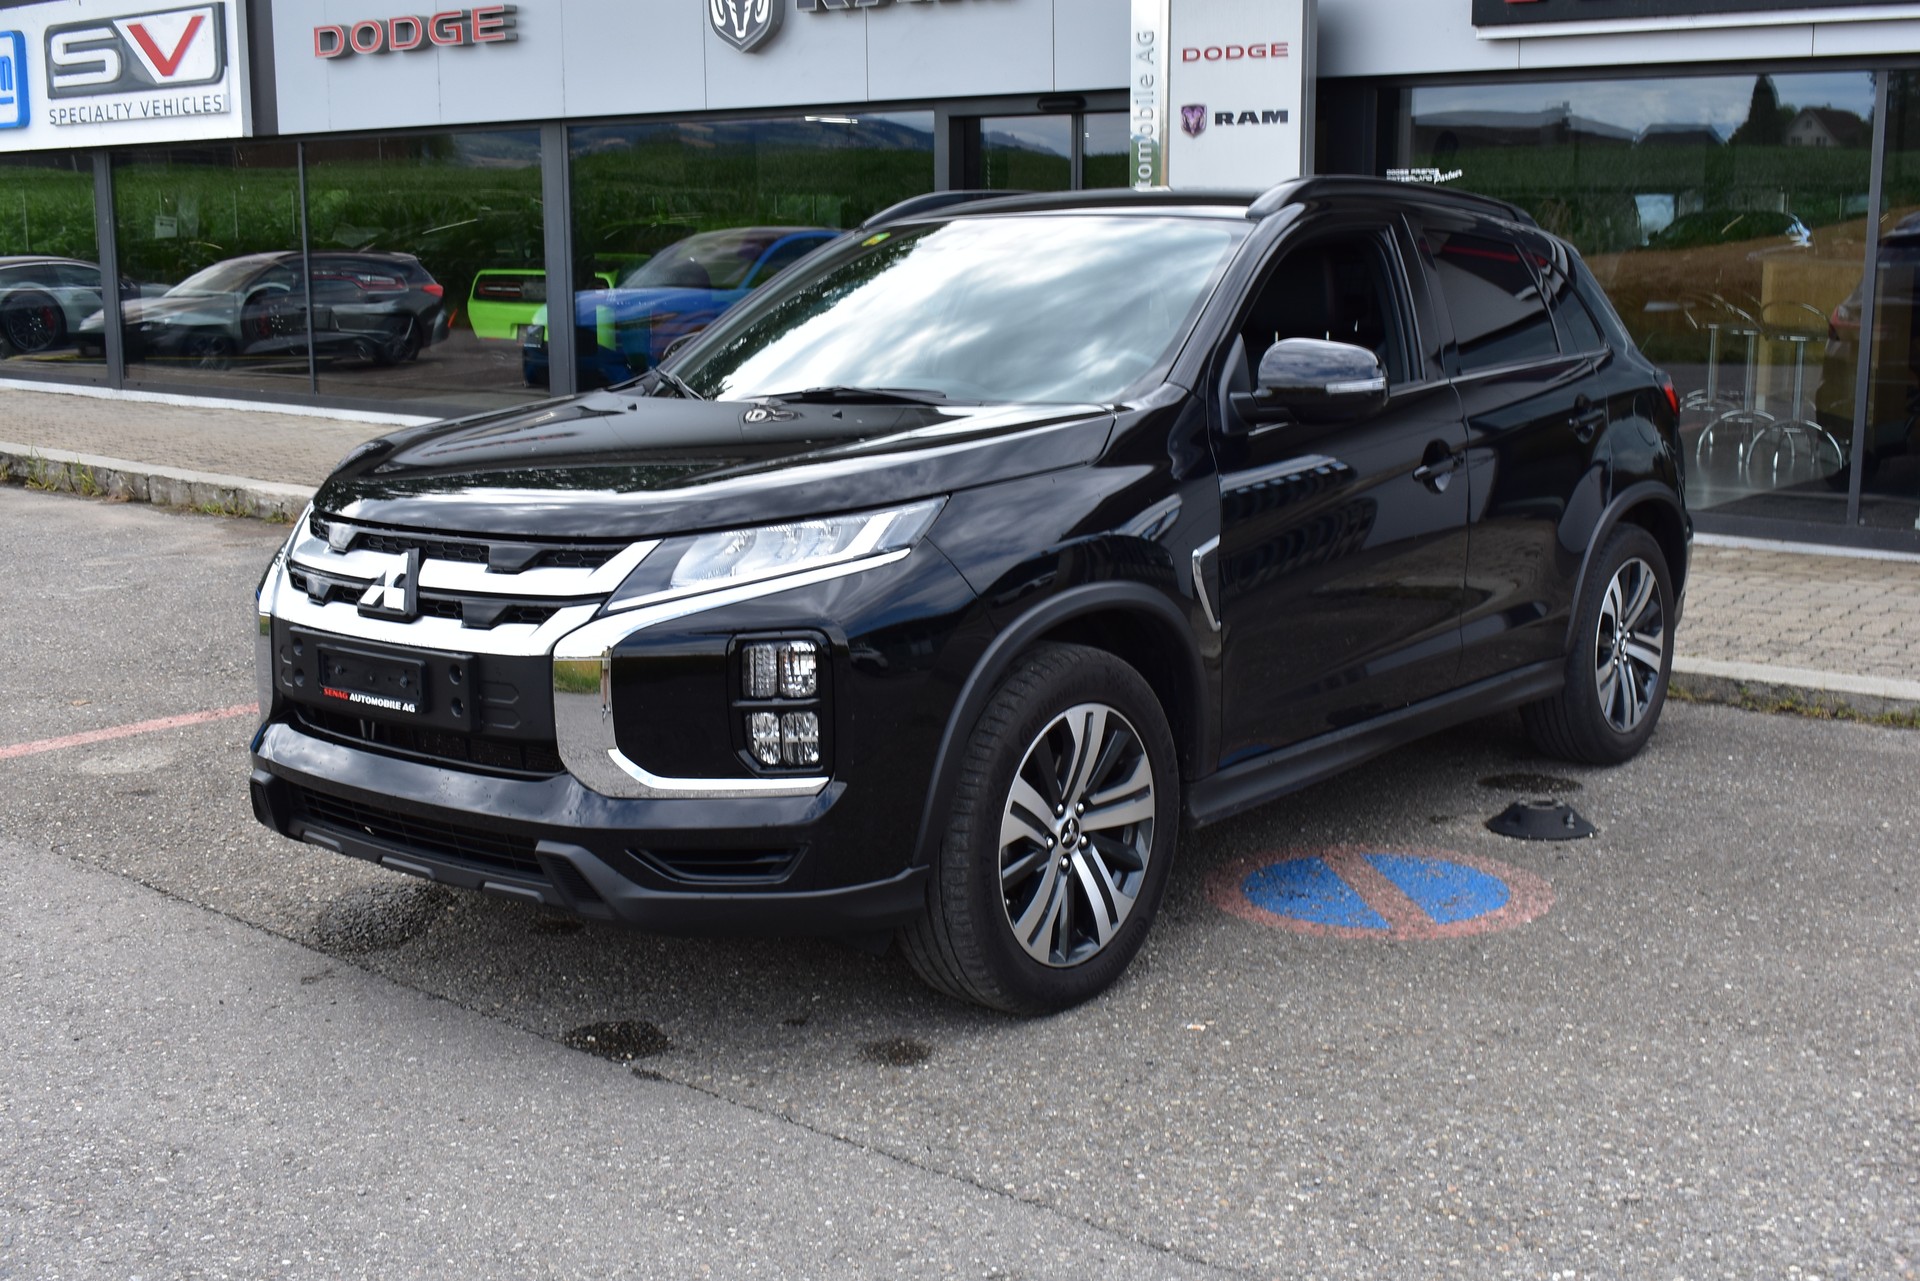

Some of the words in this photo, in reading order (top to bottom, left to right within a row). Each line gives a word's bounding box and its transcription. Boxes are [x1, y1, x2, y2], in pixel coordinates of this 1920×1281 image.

[314, 5, 507, 58] DODGE
[51, 15, 205, 88] SV
[1136, 30, 1155, 65] AG
[1182, 42, 1289, 63] DODGE
[49, 102, 133, 125] SPECIALTY
[140, 94, 222, 118] VEHICLES
[1215, 109, 1289, 126] RAM
[323, 687, 349, 700] SENAG
[349, 692, 401, 710] AUTOMOBILE
[402, 702, 416, 713] AG
